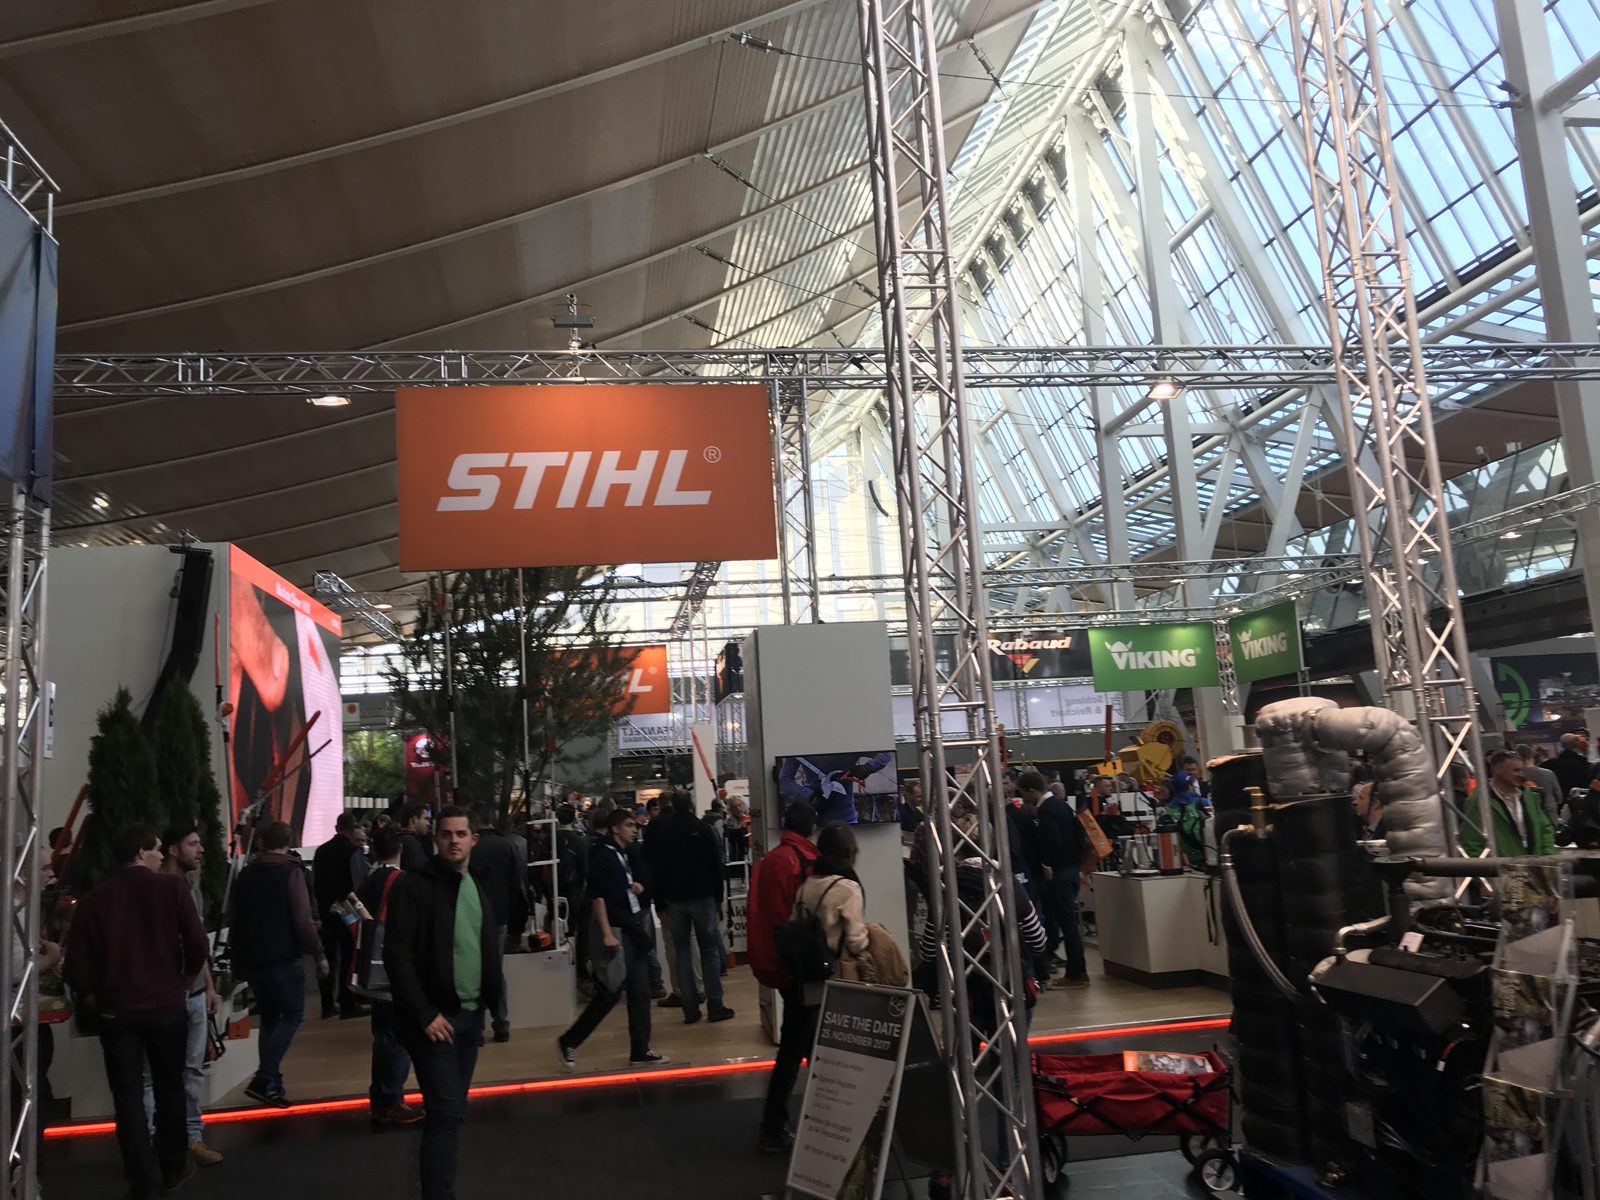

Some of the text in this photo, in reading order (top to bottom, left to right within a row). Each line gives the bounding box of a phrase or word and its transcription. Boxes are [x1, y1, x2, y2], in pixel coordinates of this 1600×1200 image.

[986, 636, 1073, 656] Rabaud
[1240, 633, 1288, 661] VIKING
[1110, 649, 1197, 670] VIKING
[823, 1010, 902, 1038] SAVE THE DATE
